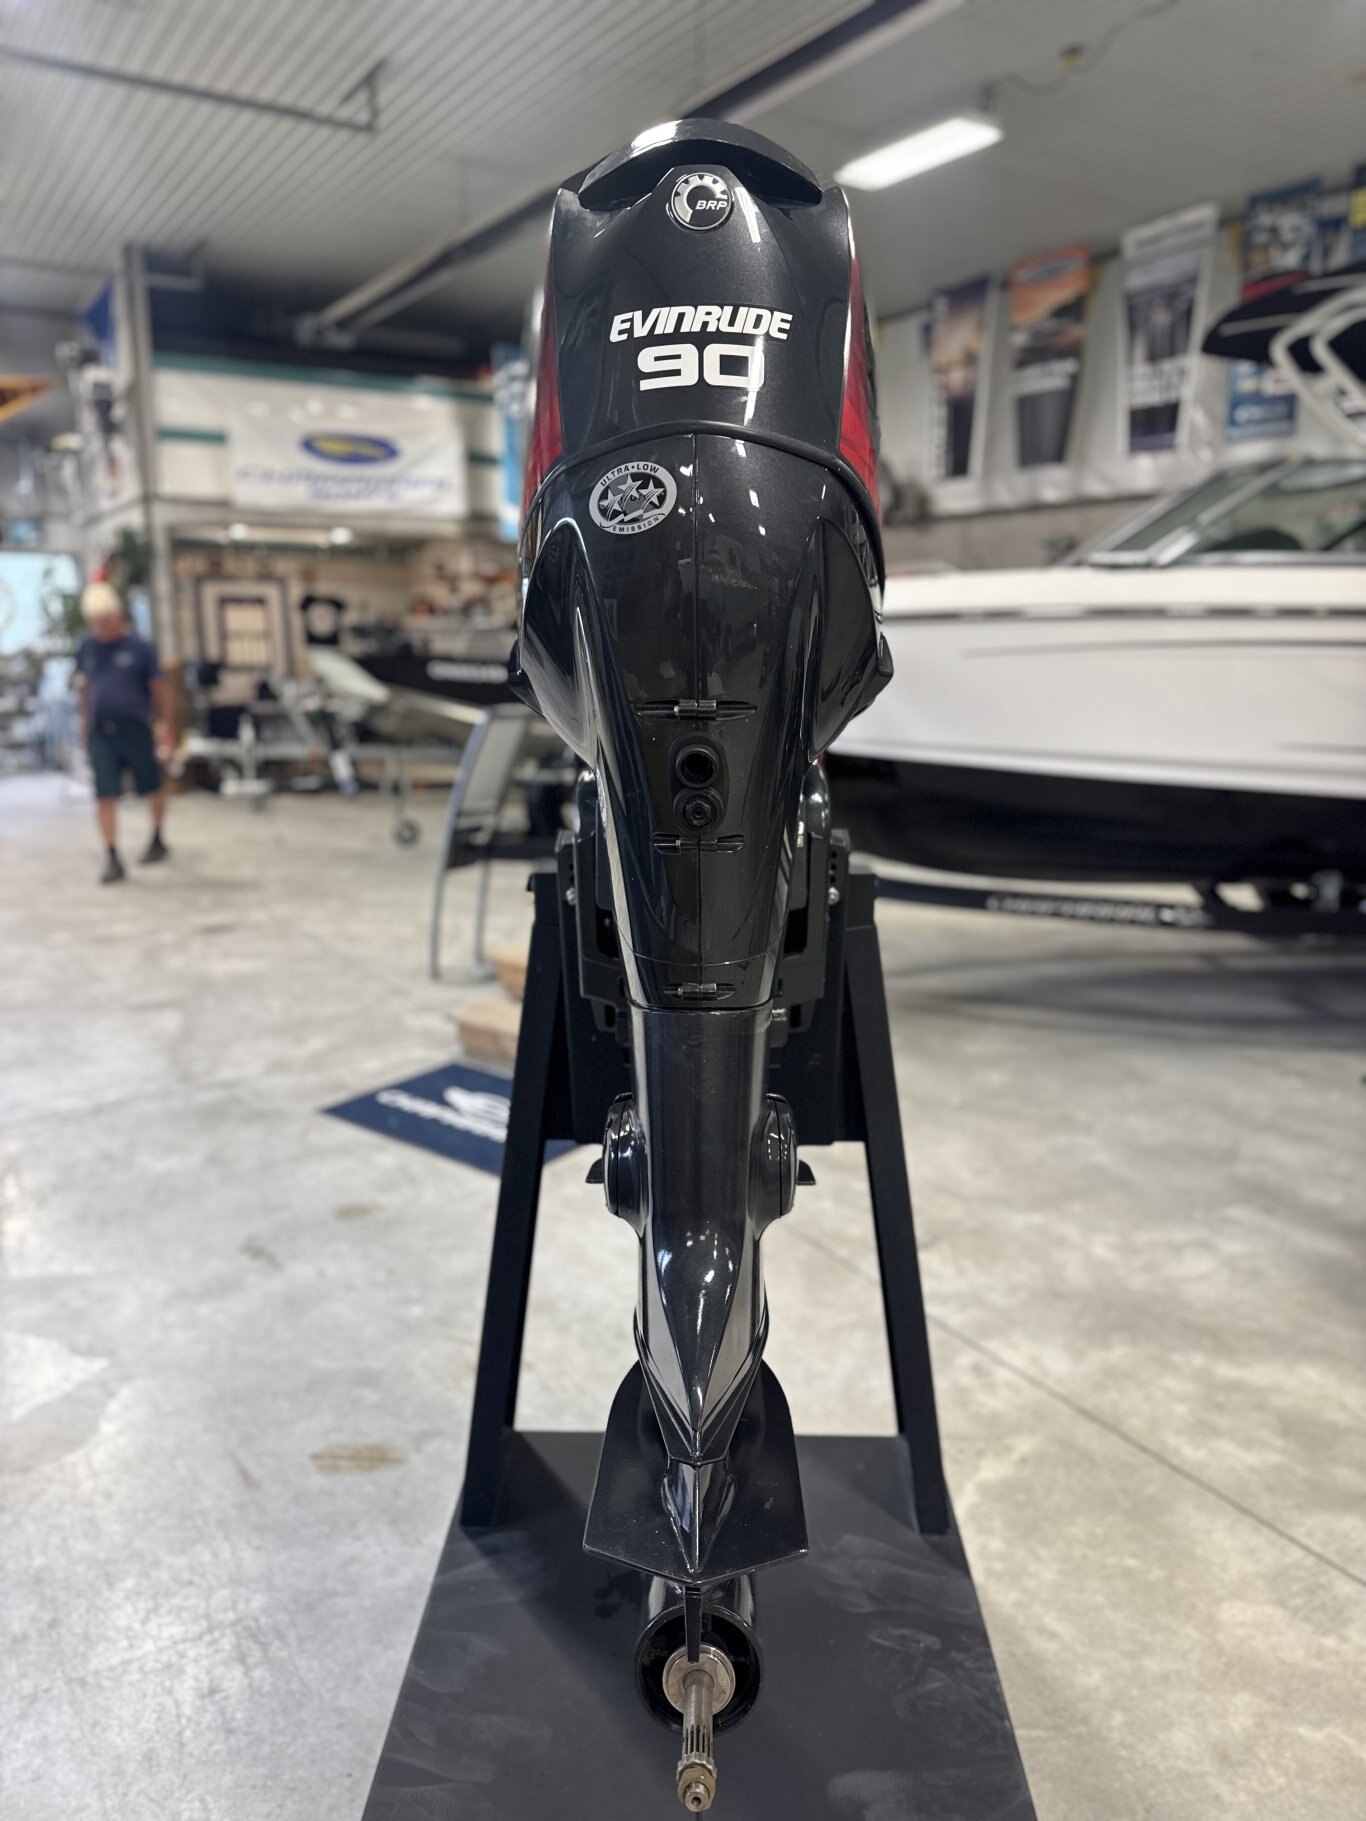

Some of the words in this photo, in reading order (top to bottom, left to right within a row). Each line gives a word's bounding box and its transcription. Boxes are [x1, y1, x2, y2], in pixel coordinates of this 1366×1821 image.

[695, 200, 728, 210] BRP
[609, 305, 793, 343] EVINRUDE
[637, 343, 765, 391] 90
[612, 516, 660, 532] EMISSION
